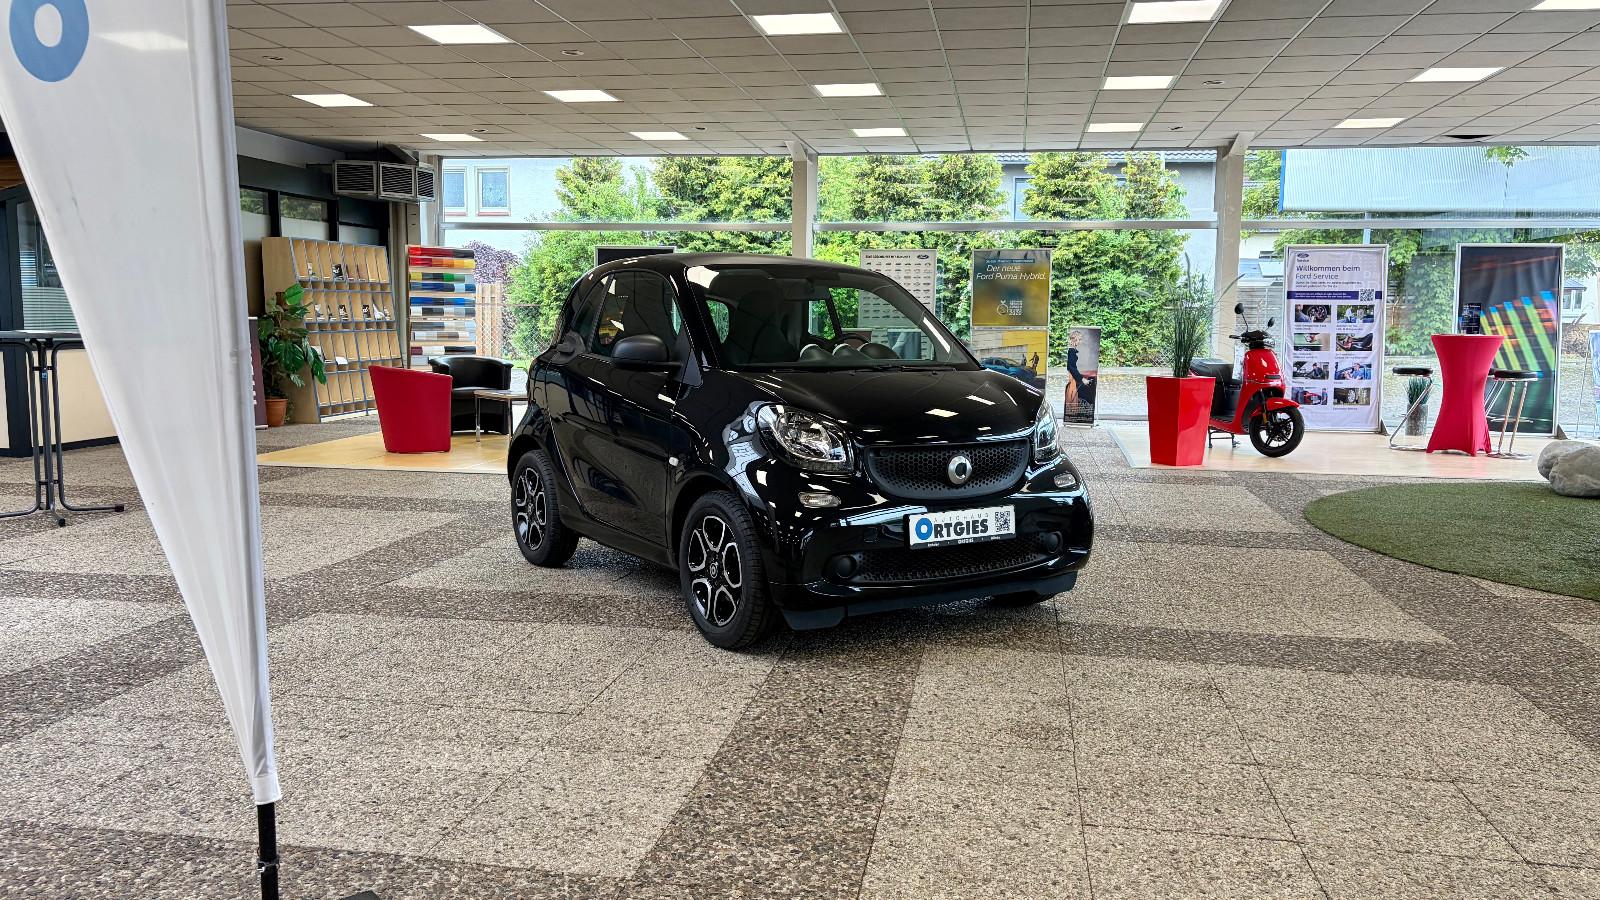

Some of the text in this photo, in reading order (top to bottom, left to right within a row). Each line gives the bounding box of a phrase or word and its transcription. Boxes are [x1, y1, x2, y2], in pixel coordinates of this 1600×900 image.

[986, 264, 1000, 272] Der
[976, 272, 1047, 281] Ford Puma Hybrid.
[1295, 272, 1339, 280] Ford Service
[914, 517, 989, 541] ORTGIES
